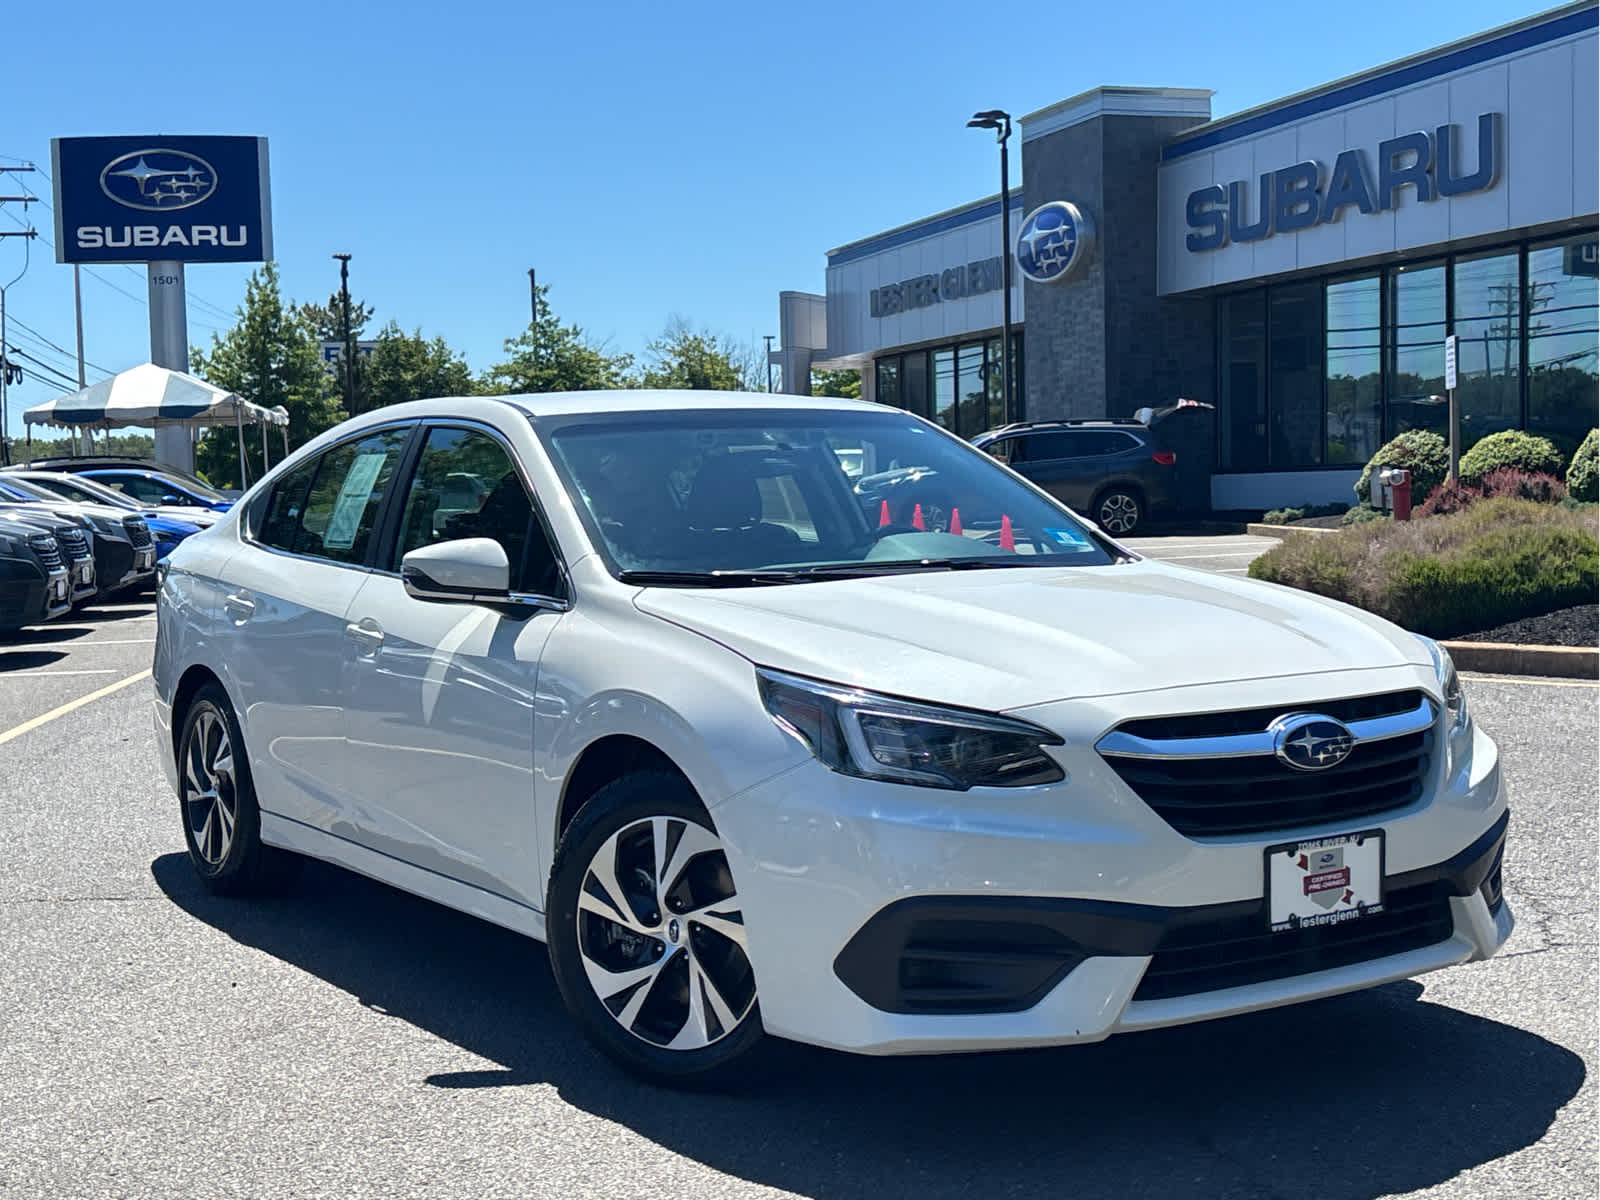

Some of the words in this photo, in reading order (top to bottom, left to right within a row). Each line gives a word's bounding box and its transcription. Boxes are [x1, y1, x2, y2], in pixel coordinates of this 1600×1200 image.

[1185, 111, 1500, 253] SUBARU
[77, 225, 248, 248] SUBARU
[153, 275, 178, 285] 1501
[870, 272, 941, 318] LESTER
[1300, 907, 1359, 928] lesterglenn
